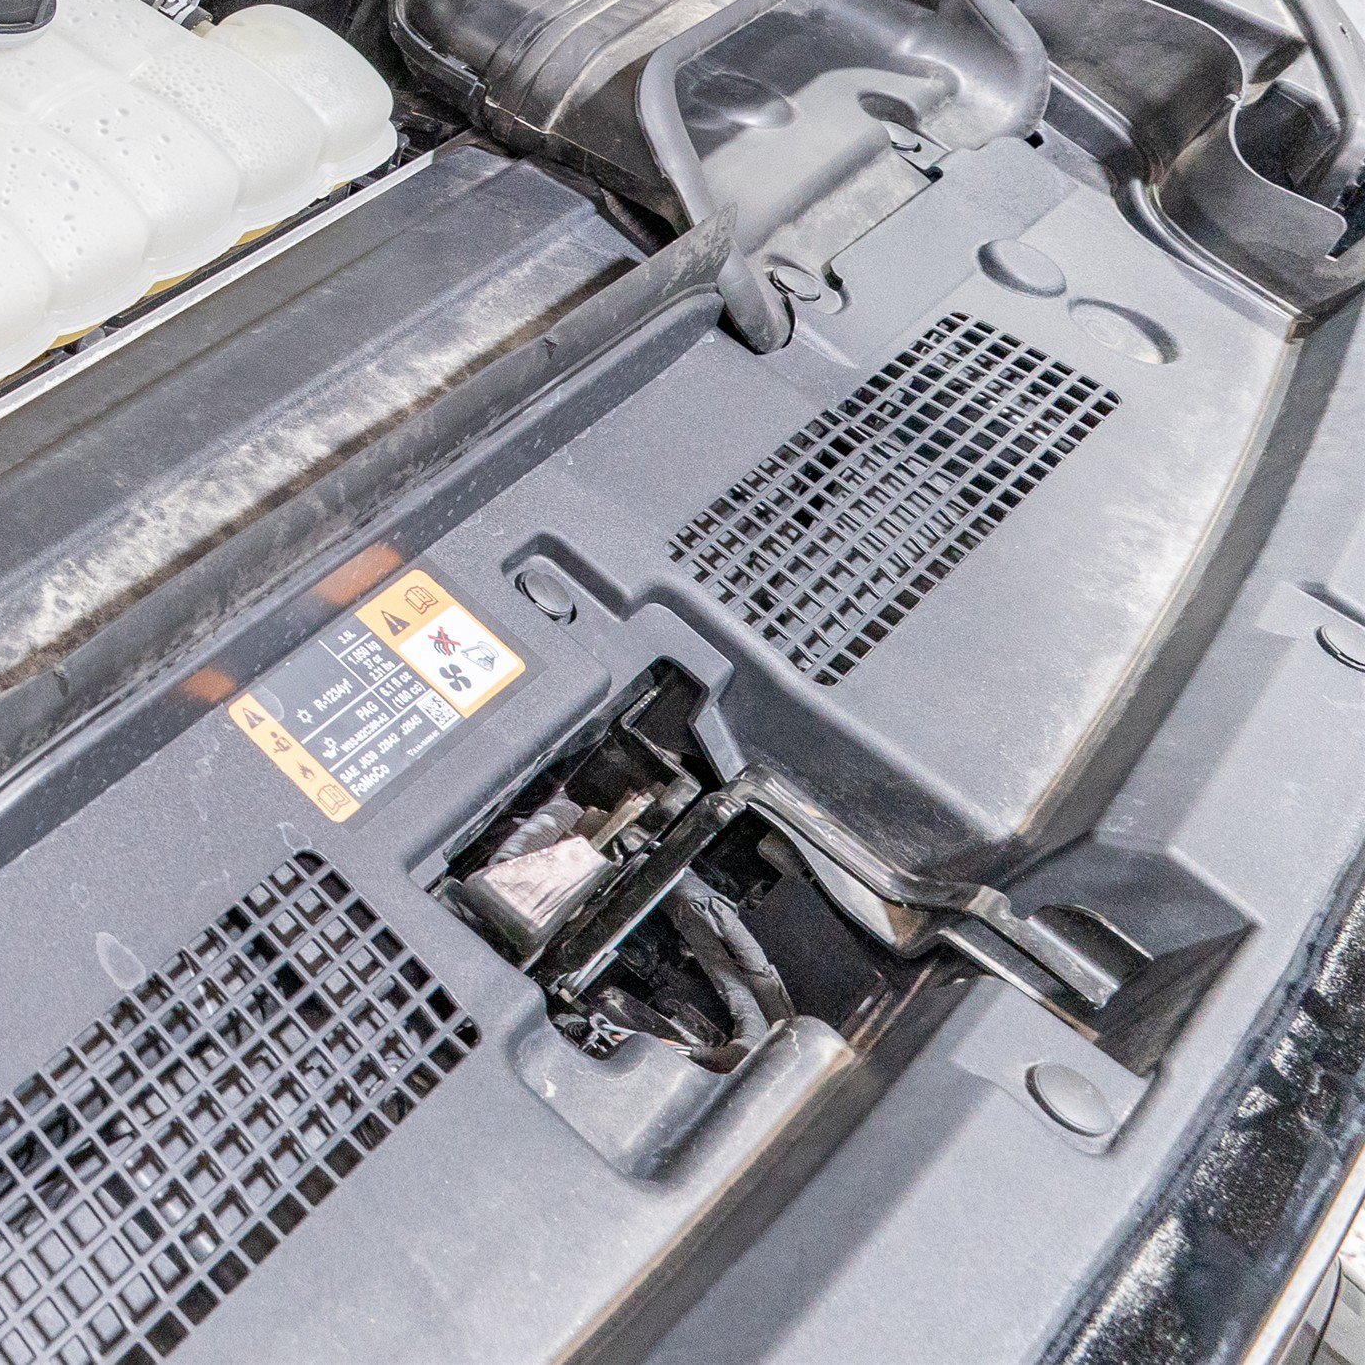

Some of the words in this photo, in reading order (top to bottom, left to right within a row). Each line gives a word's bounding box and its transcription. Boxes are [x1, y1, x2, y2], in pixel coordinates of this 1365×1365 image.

[346, 646, 371, 667] 1.050
[364, 639, 382, 654] kg
[363, 658, 376, 670] 37
[371, 653, 384, 664] oz
[380, 658, 396, 672] lbs
[311, 677, 356, 714] R-1234yf
[378, 682, 396, 698] 6.1
[389, 677, 403, 689] fl
[397, 670, 413, 684] oz
[390, 689, 414, 710] (180
[406, 679, 427, 697] cc)
[354, 699, 379, 721] PAG
[338, 763, 360, 784] SAE
[356, 748, 380, 770] J639
[375, 731, 401, 754] J2842
[397, 713, 423, 736] J2845
[349, 760, 391, 798] FoMoCo
